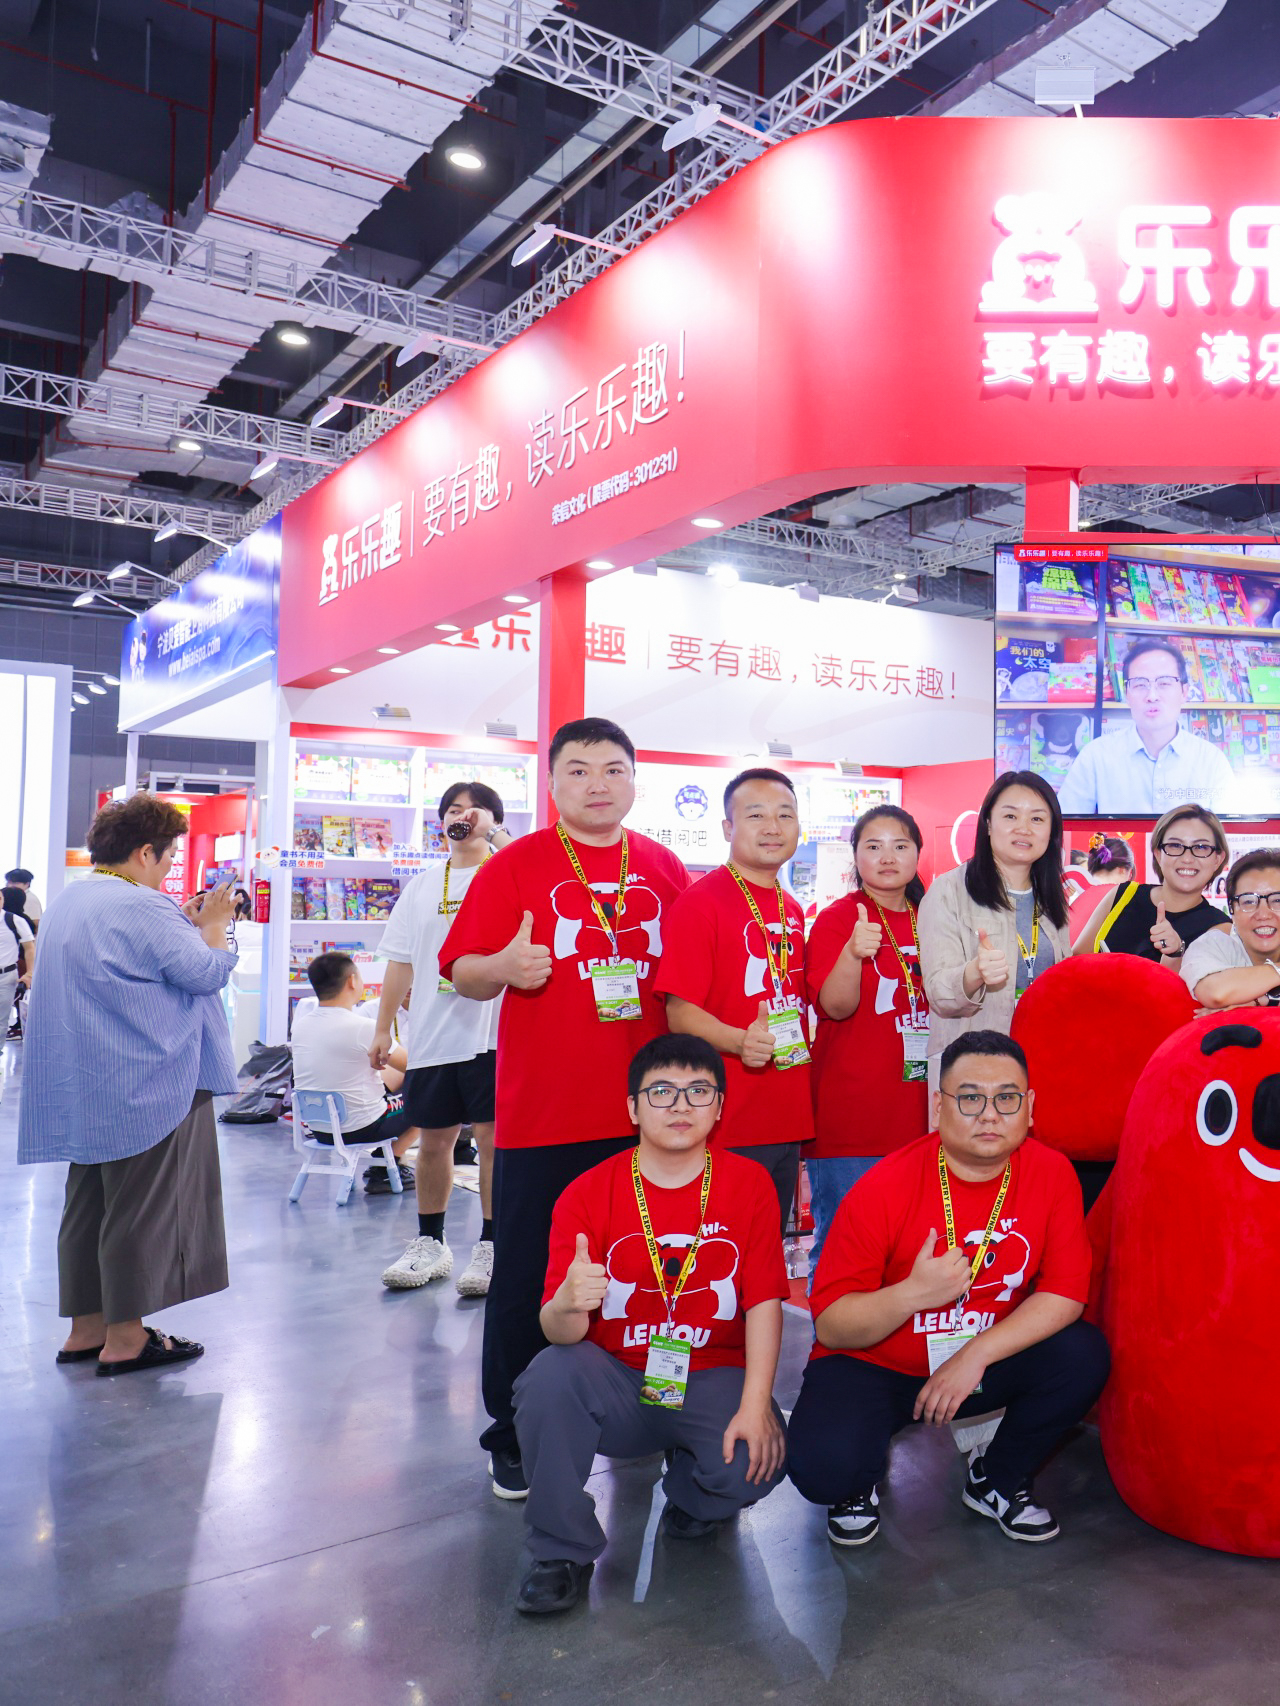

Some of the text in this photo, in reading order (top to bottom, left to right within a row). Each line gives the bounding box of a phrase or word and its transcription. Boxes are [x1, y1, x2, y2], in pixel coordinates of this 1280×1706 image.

[341, 501, 403, 591] 乐乐趣
[279, 859, 325, 869] 会员免费借
[280, 849, 325, 860] 童书不用买
[562, 837, 578, 866] INDUSTRY
[619, 852, 628, 897] INTERNATIONAL
[702, 1155, 712, 1192] CHILDREN
[940, 1164, 950, 1201] INDUSTRY
[632, 1175, 647, 1213] INDUSTRY
[642, 1214, 653, 1237] EXPO
[945, 1203, 953, 1225] EXPO
[982, 1191, 1005, 1248] INTERNATIONAL
[647, 1237, 657, 1257] 2024
[947, 1227, 955, 1247] 2024
